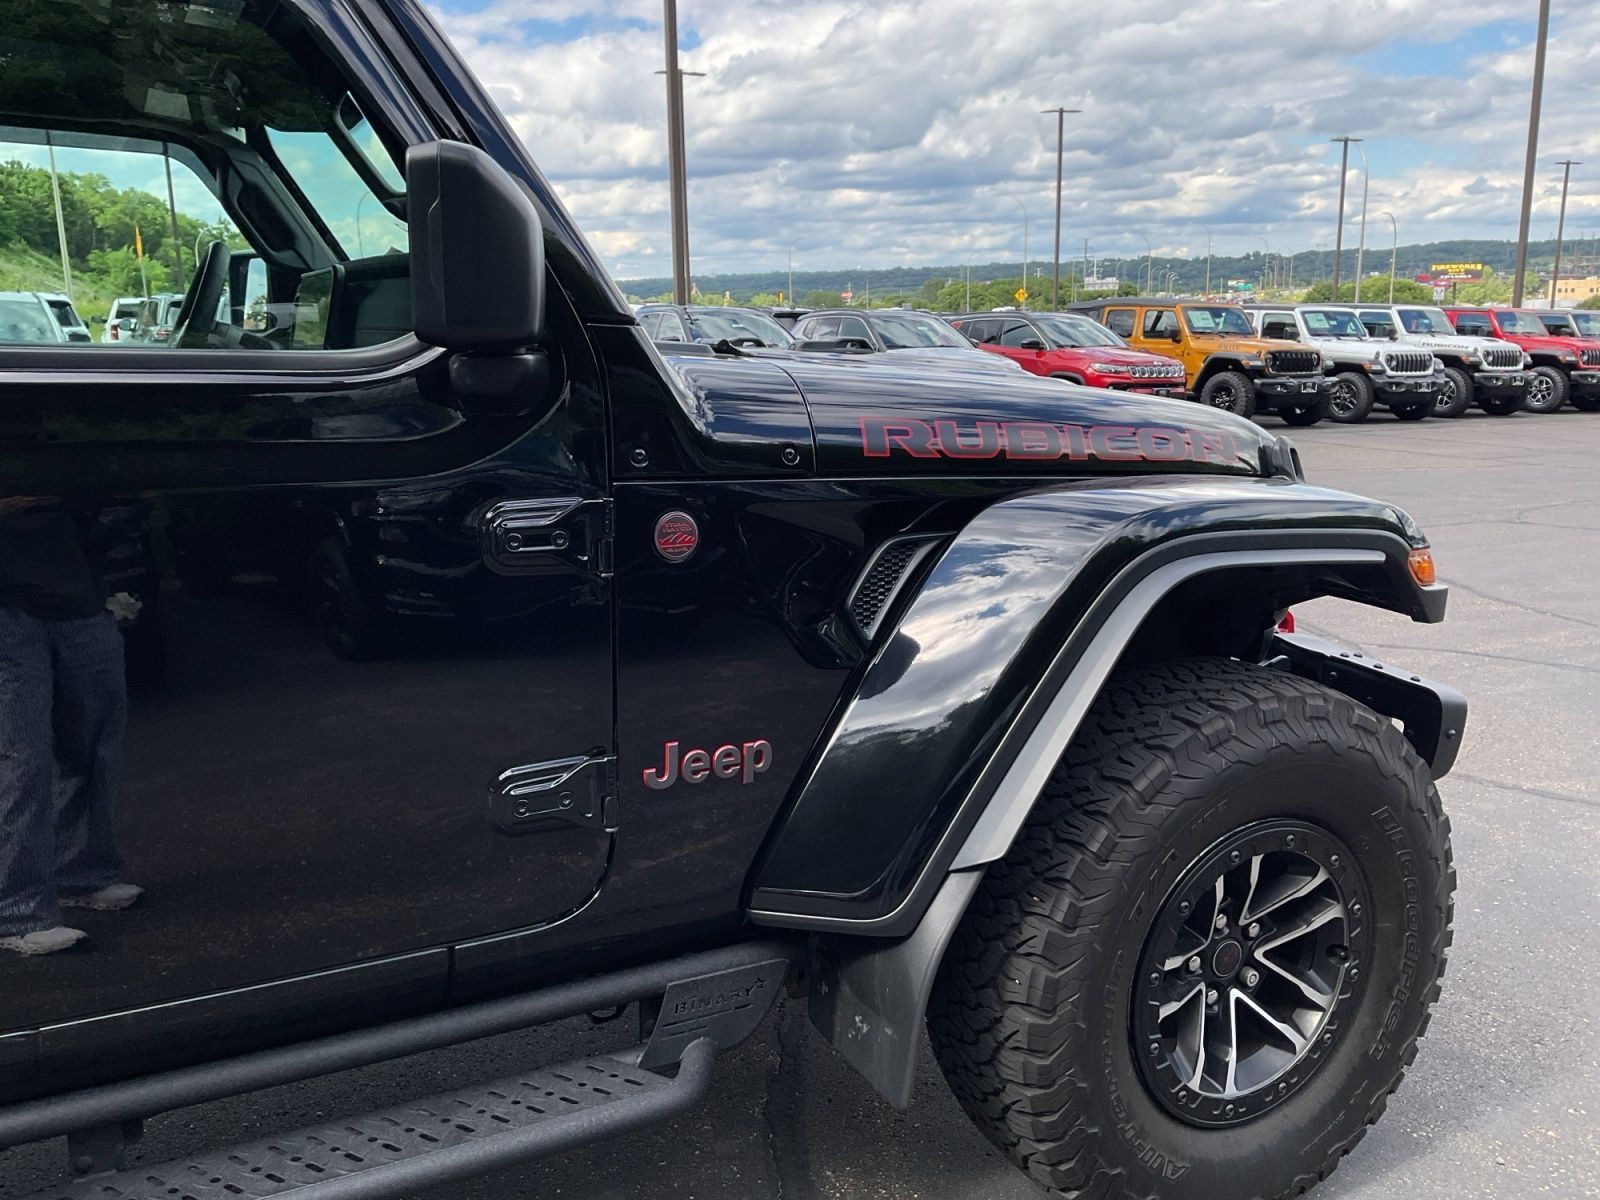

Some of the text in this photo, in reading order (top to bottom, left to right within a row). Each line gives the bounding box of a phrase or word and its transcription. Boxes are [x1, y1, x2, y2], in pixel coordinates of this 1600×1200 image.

[1431, 263, 1483, 271] FIREWORKS
[857, 416, 1240, 463] RUBICON
[642, 739, 773, 789] Jeep
